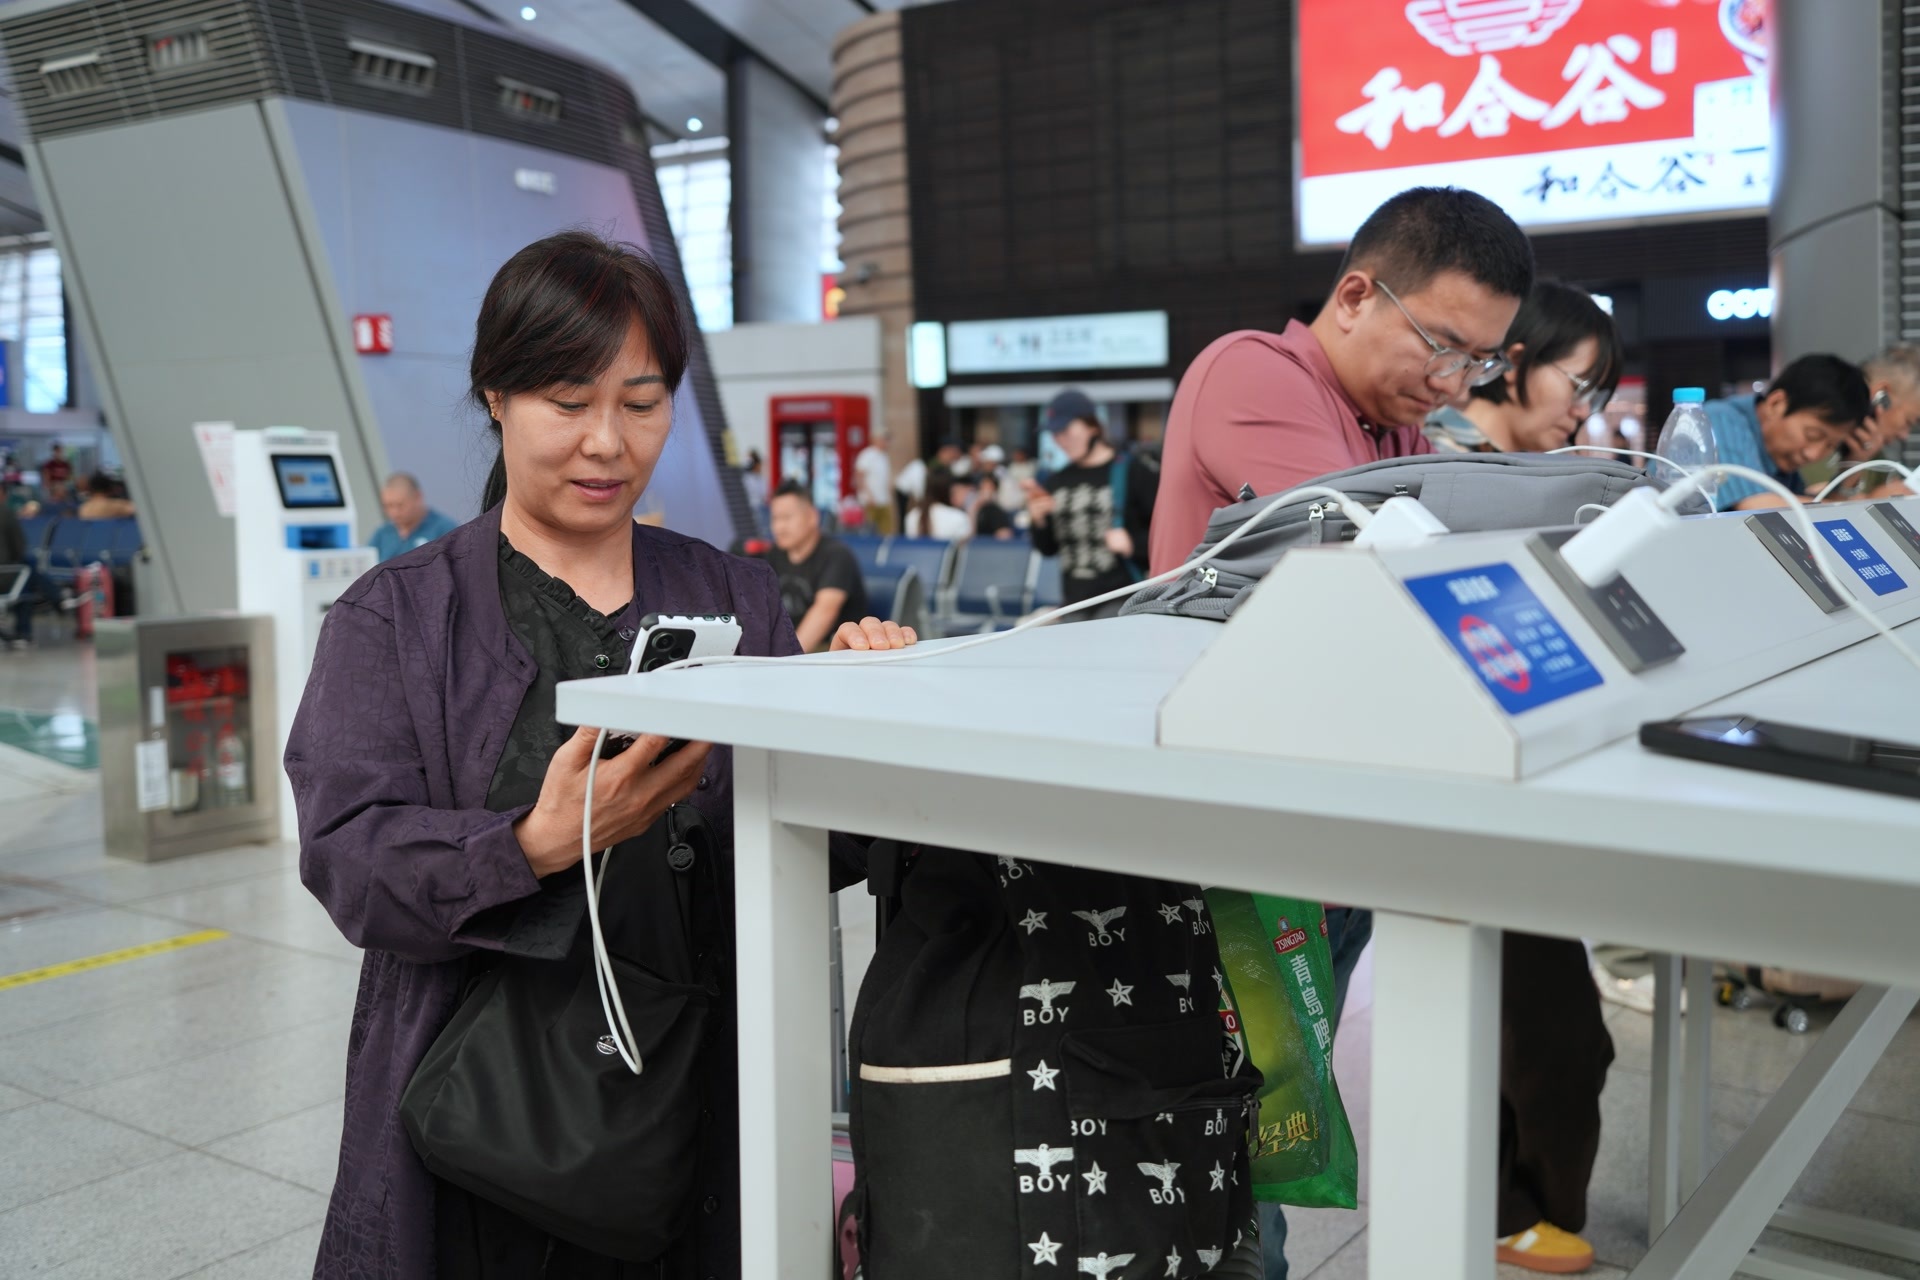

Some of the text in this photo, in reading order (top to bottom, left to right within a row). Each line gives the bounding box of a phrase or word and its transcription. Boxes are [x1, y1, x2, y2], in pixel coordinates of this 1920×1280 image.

[1335, 35, 1666, 151] 和合谷
[1523, 152, 1706, 202] 和合谷
[1088, 928, 1126, 947] BOY
[1192, 920, 1211, 936] BOY
[1275, 930, 1305, 951] TSINGTAO
[1023, 1006, 1069, 1026] BOY
[1204, 1118, 1228, 1136] BOY
[1019, 1173, 1071, 1194] BOY
[1149, 1187, 1186, 1205] BOY
